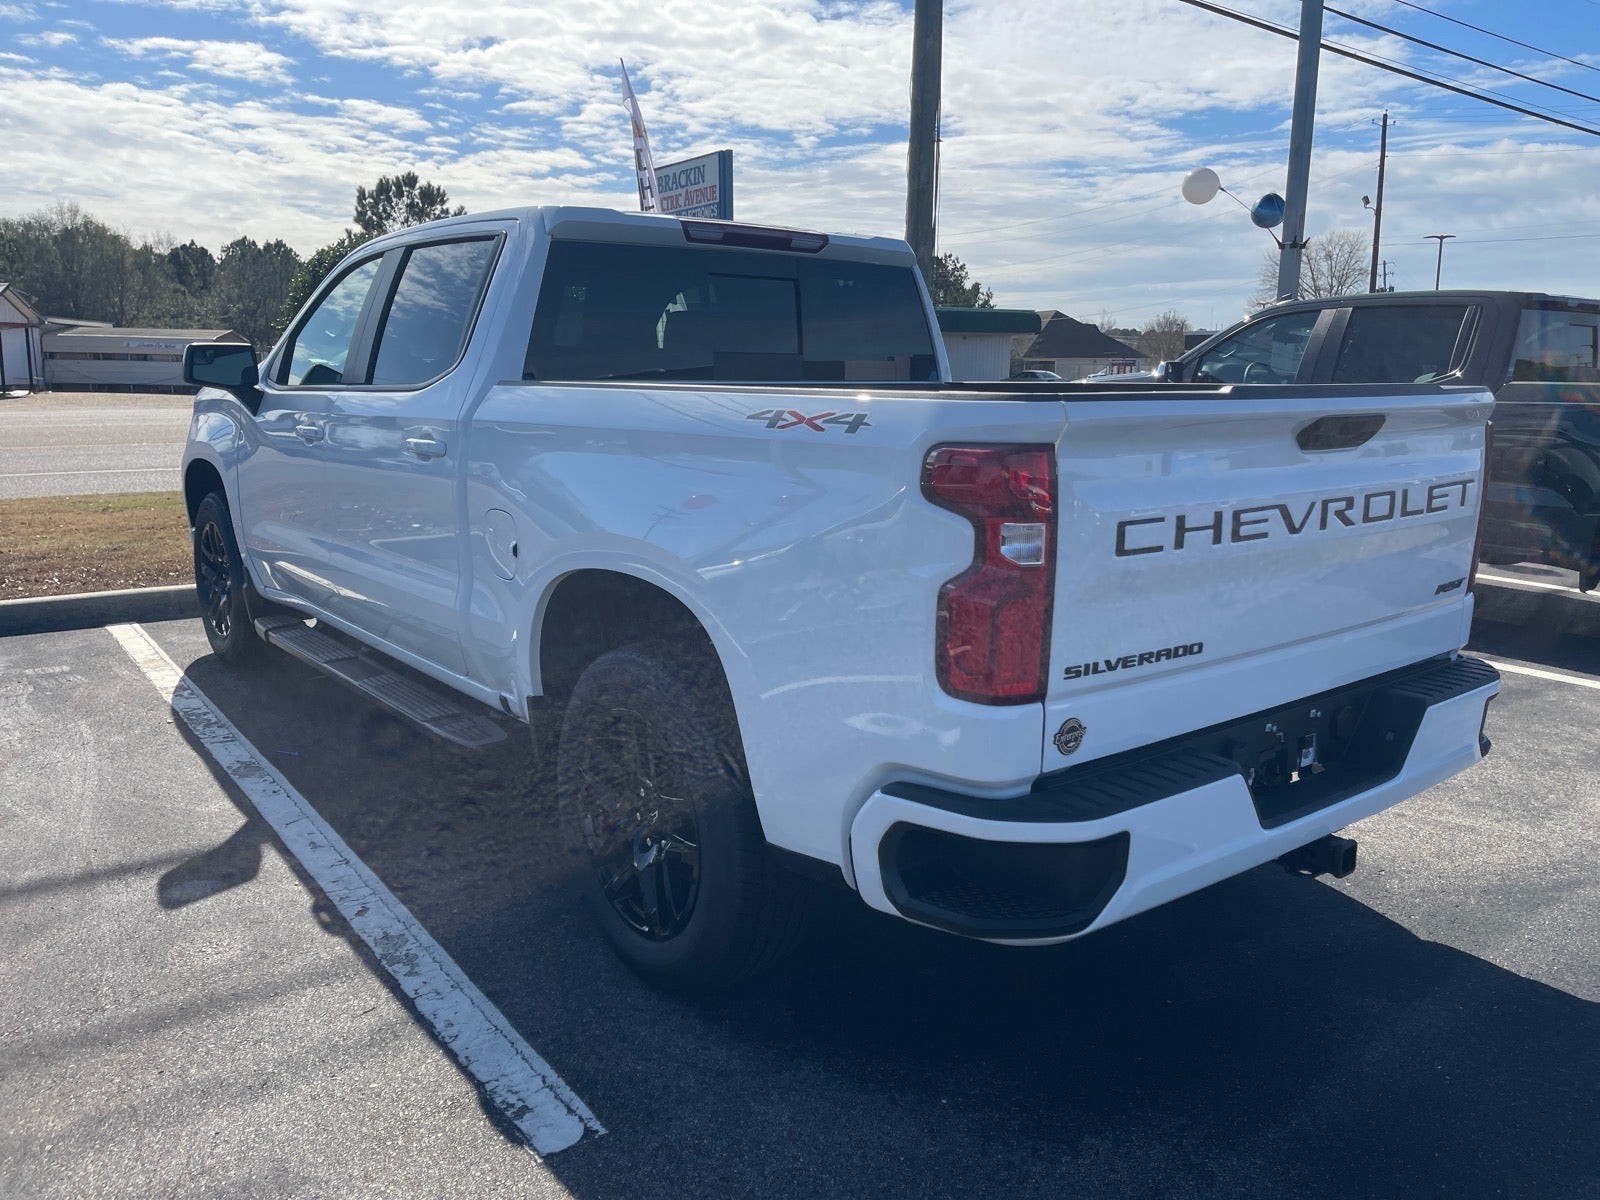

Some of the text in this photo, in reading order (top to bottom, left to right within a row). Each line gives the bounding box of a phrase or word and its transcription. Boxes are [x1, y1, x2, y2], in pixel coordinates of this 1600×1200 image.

[657, 164, 705, 194] BRACKIN
[684, 184, 717, 207] AVENUE
[1115, 479, 1475, 558] CHEVROLET
[1063, 641, 1204, 681] SILVERADO
